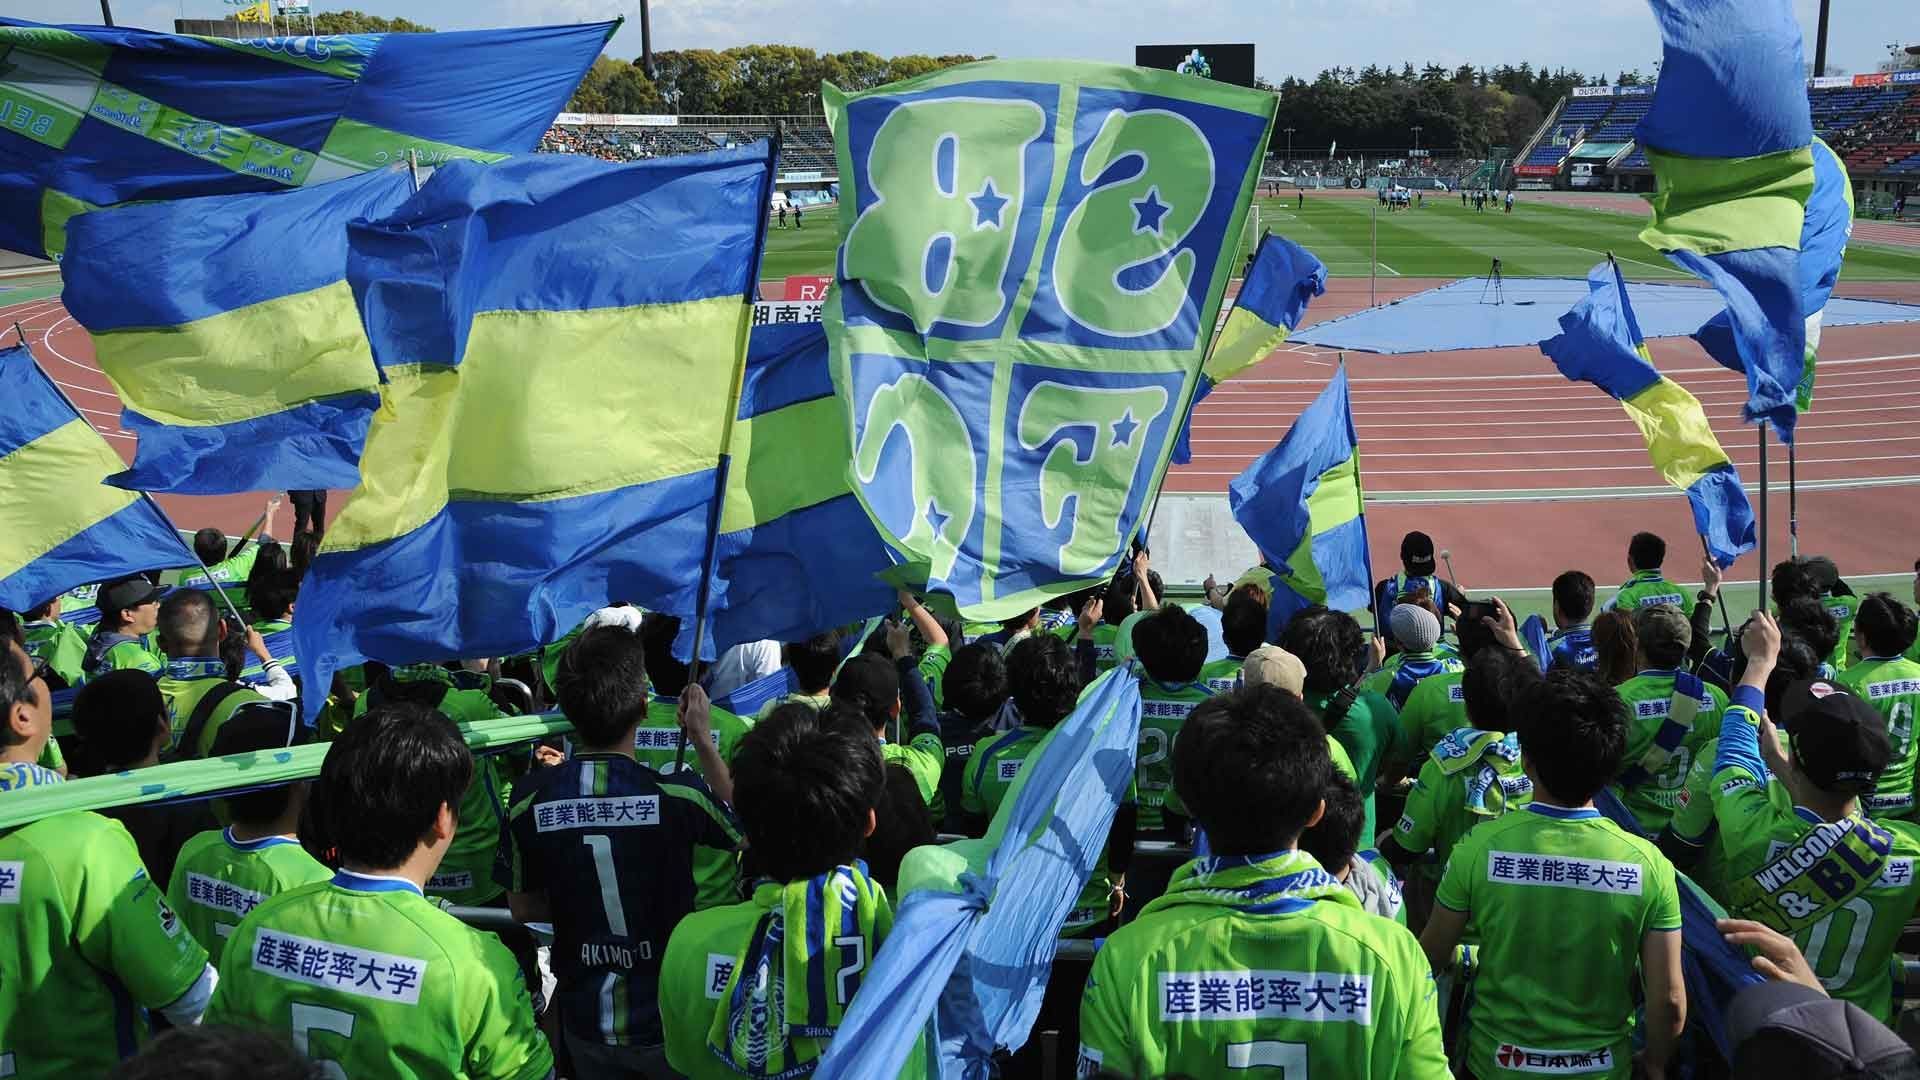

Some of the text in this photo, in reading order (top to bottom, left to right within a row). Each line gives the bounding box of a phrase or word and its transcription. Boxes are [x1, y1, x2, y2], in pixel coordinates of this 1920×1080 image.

[538, 800, 656, 828] 産業能率大学
[1492, 856, 1638, 889] 産業能率大学
[1755, 819, 1852, 893] WELCOME
[583, 834, 628, 937] 1
[256, 936, 417, 995] 産業能率大学
[582, 940, 652, 969] AKIMOO
[1165, 977, 1367, 1014] 産業能率大学
